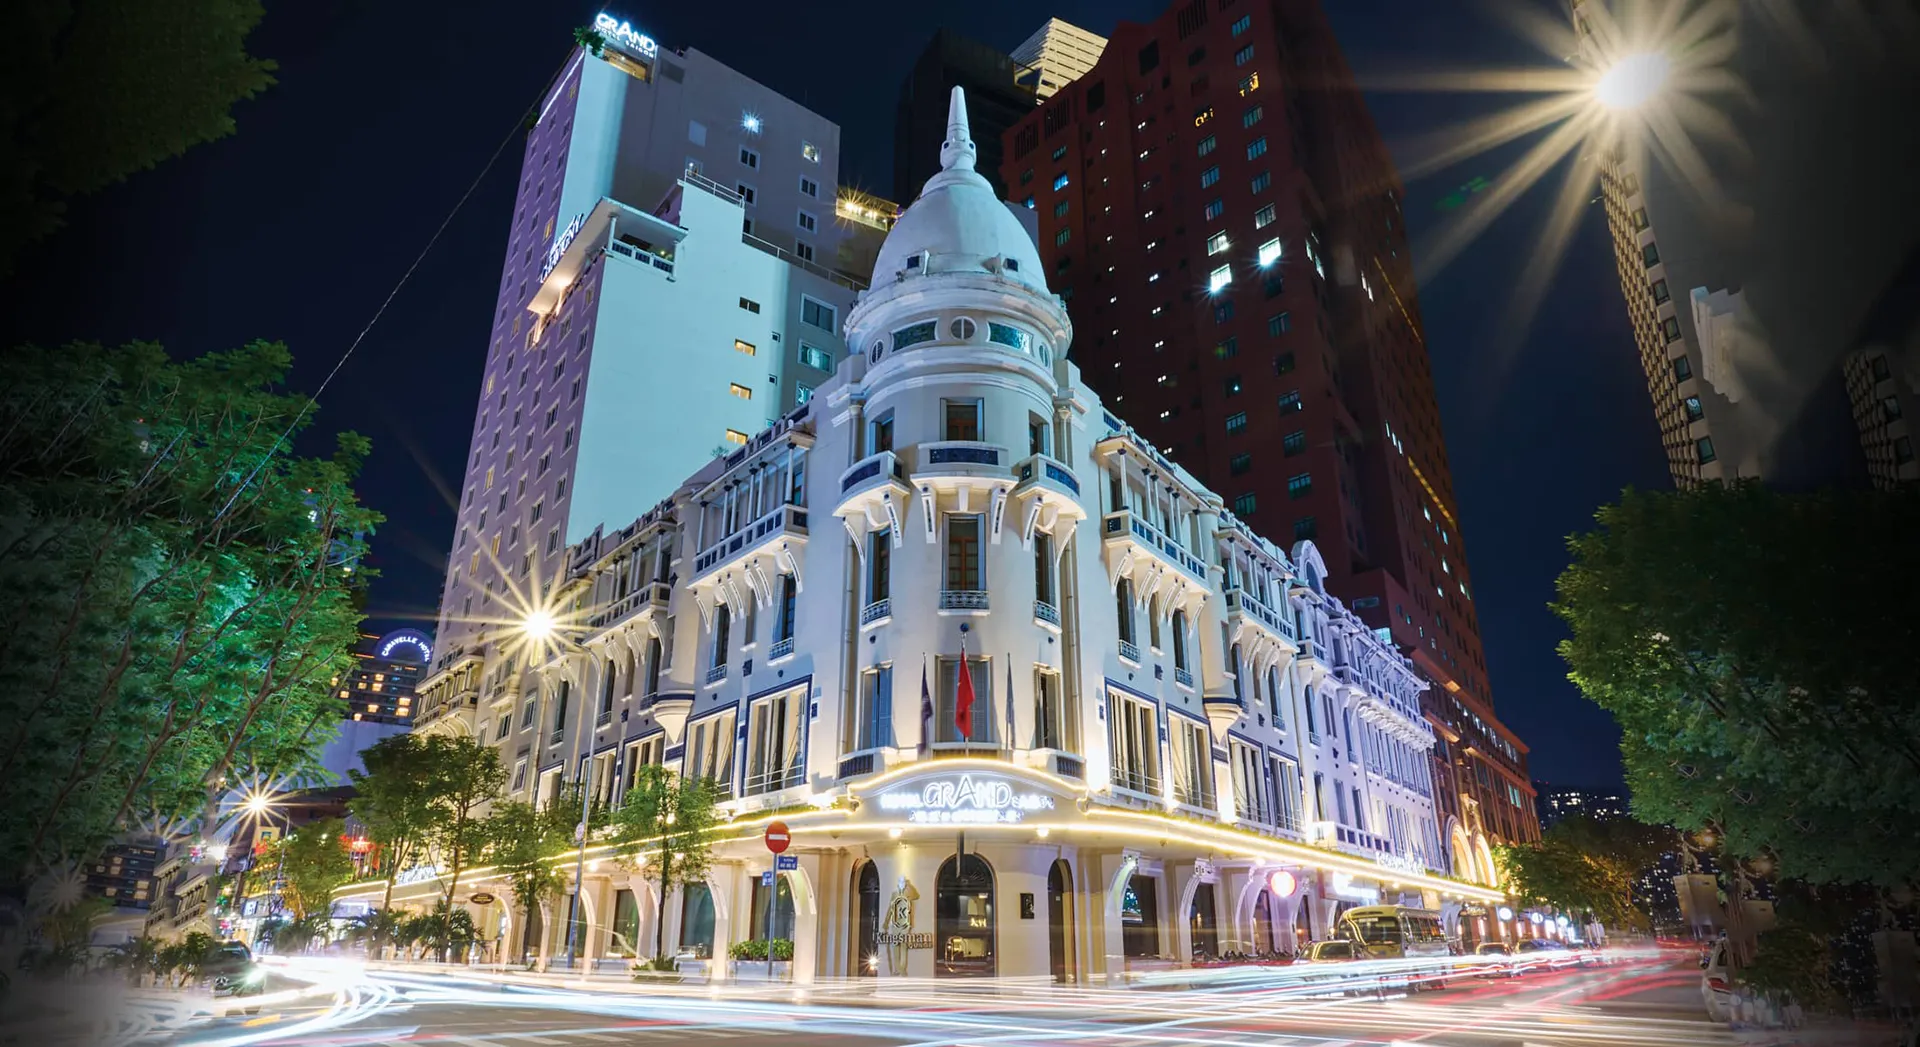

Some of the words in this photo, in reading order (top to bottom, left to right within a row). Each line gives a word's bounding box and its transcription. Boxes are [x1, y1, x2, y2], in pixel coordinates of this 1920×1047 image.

[596, 13, 656, 51] GRAND
[625, 40, 654, 58] SAIGON
[381, 636, 418, 656] CARAVELLE
[418, 642, 430, 662] HOTEL
[924, 775, 1011, 808] GRAND
[876, 932, 932, 946] Kingsman
